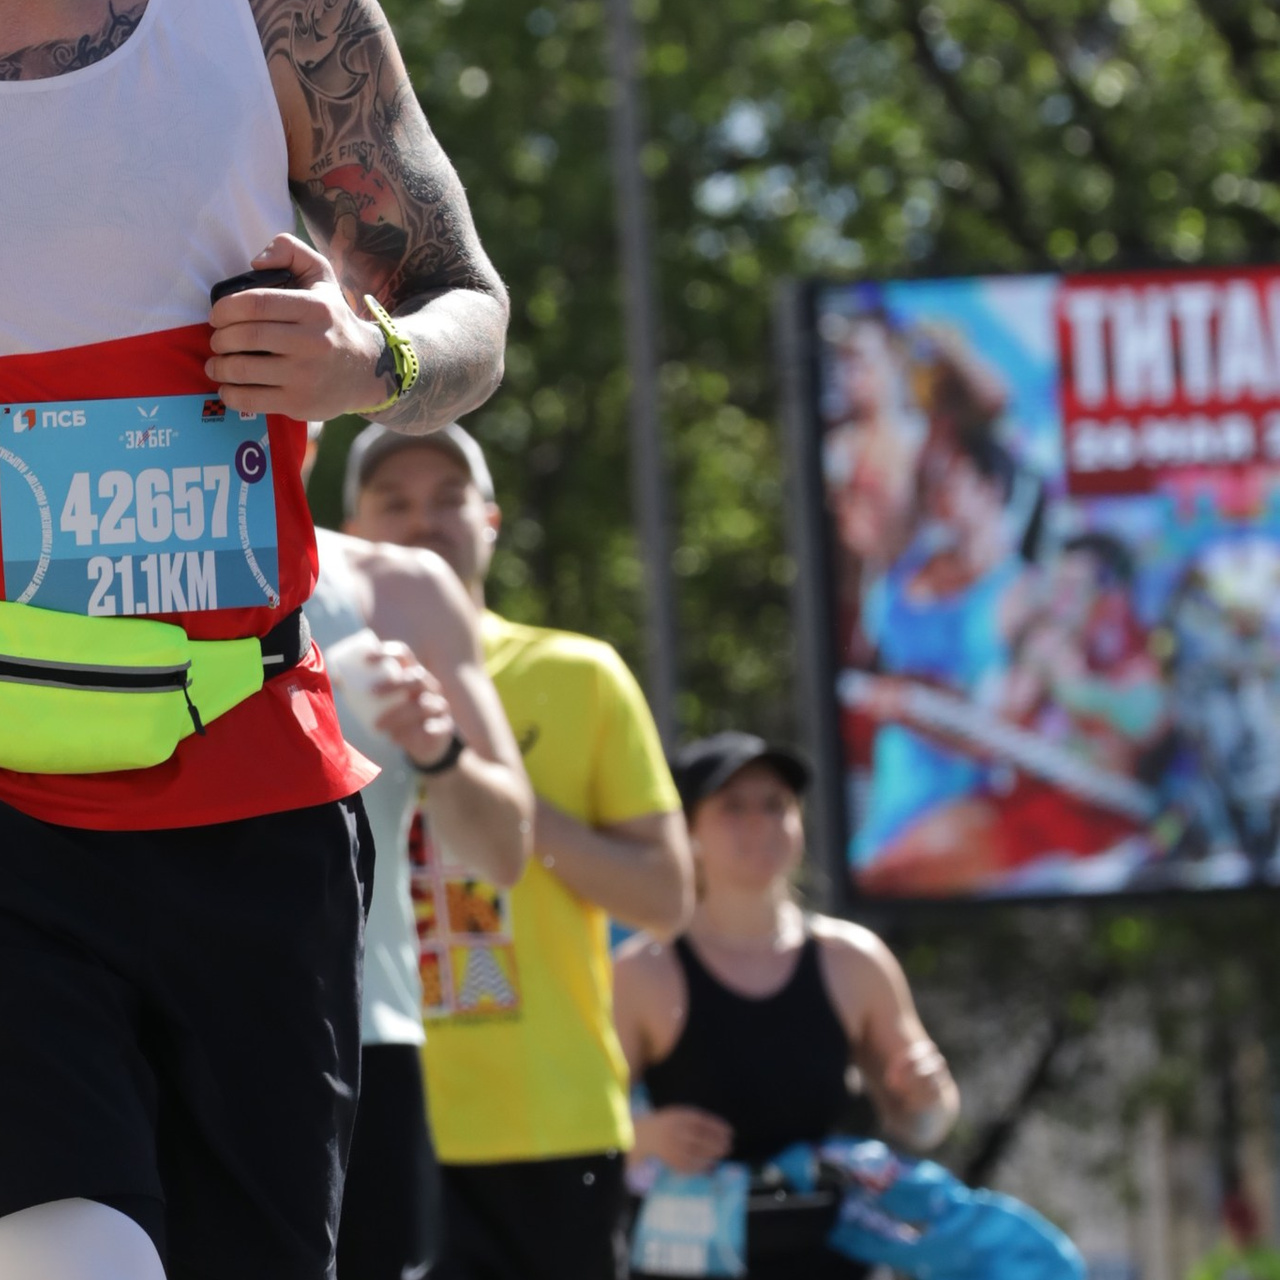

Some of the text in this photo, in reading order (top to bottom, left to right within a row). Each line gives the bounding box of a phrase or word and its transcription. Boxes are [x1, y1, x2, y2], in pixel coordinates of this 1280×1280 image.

[310, 151, 333, 176] THE
[339, 140, 375, 161] FIRST
[42, 409, 87, 428] ПСБ
[60, 464, 231, 547] 42657
[87, 550, 218, 617] 21.1KM
